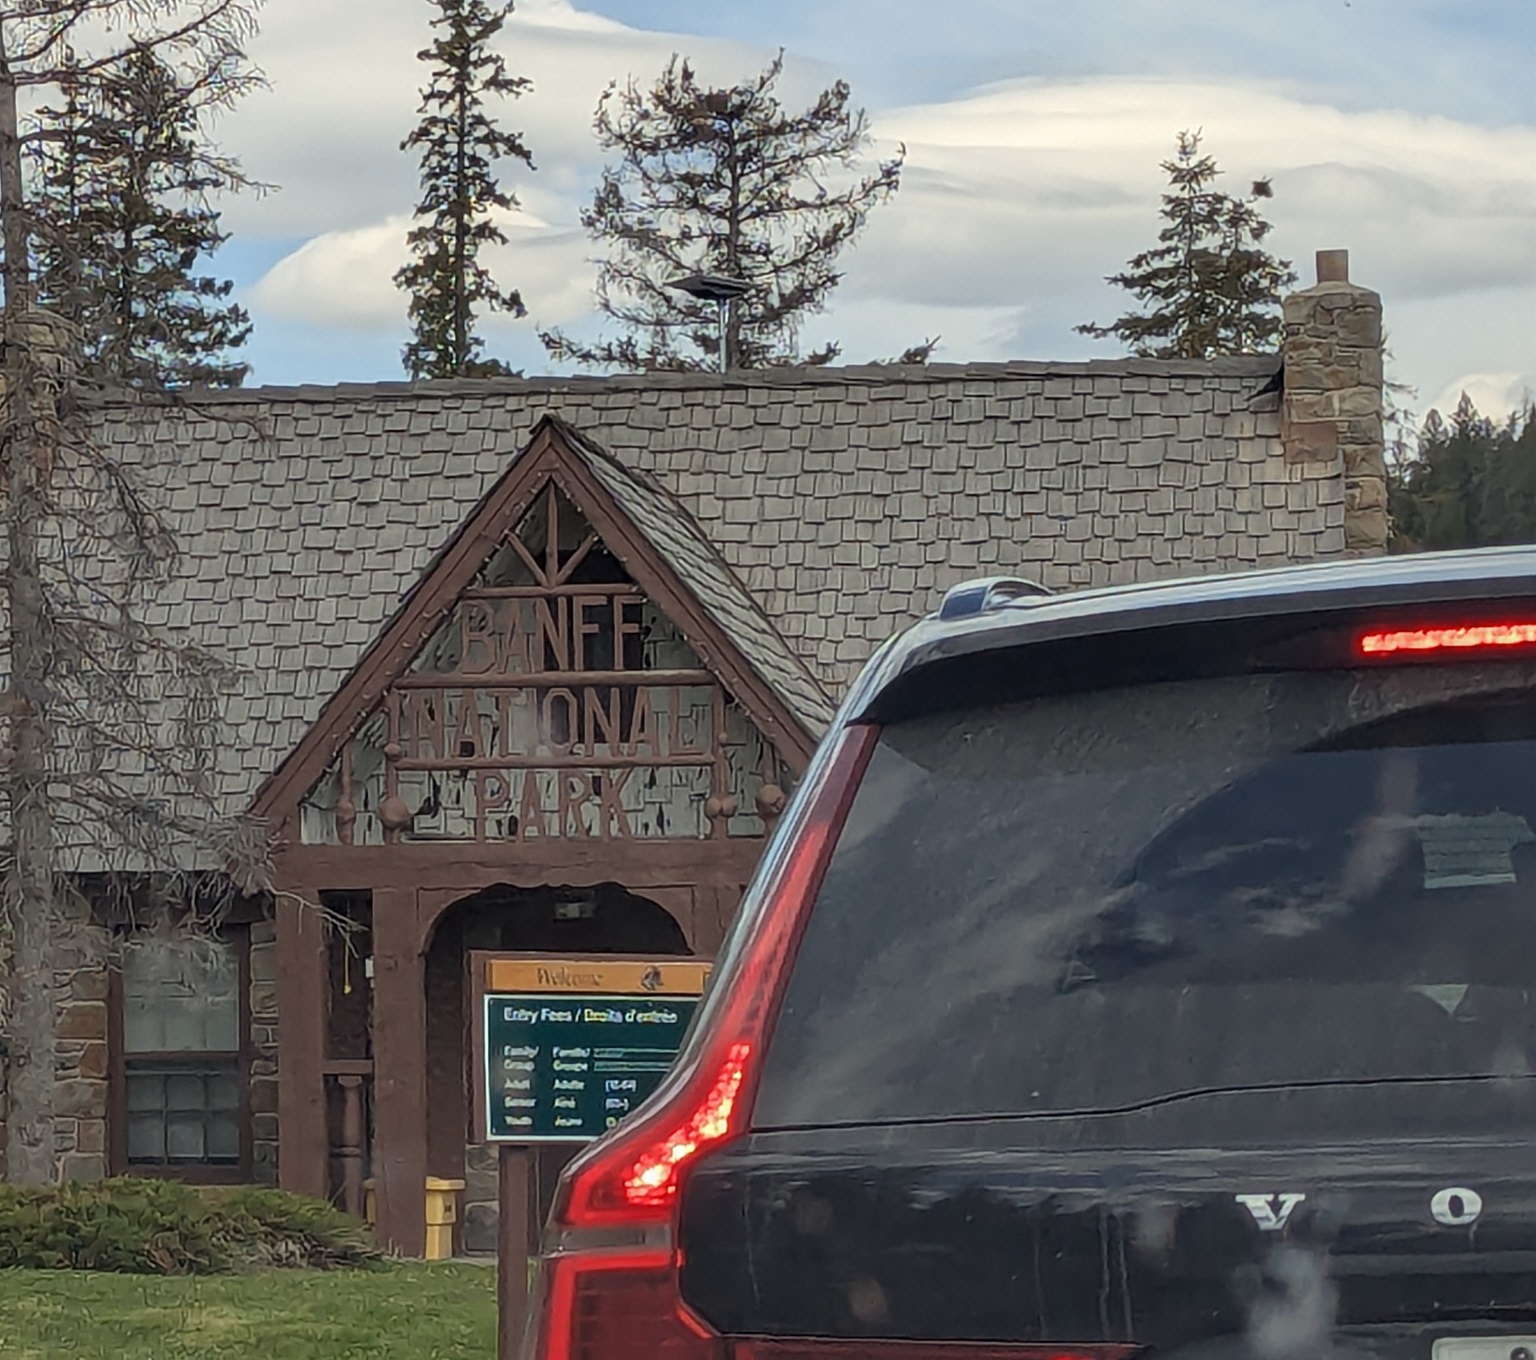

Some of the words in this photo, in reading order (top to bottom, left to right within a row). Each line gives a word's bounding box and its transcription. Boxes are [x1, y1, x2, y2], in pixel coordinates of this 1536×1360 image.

[460, 595, 646, 674] BANFF
[476, 769, 632, 840] PARK
[503, 1006, 538, 1024] Entry
[540, 1008, 572, 1022] Fees
